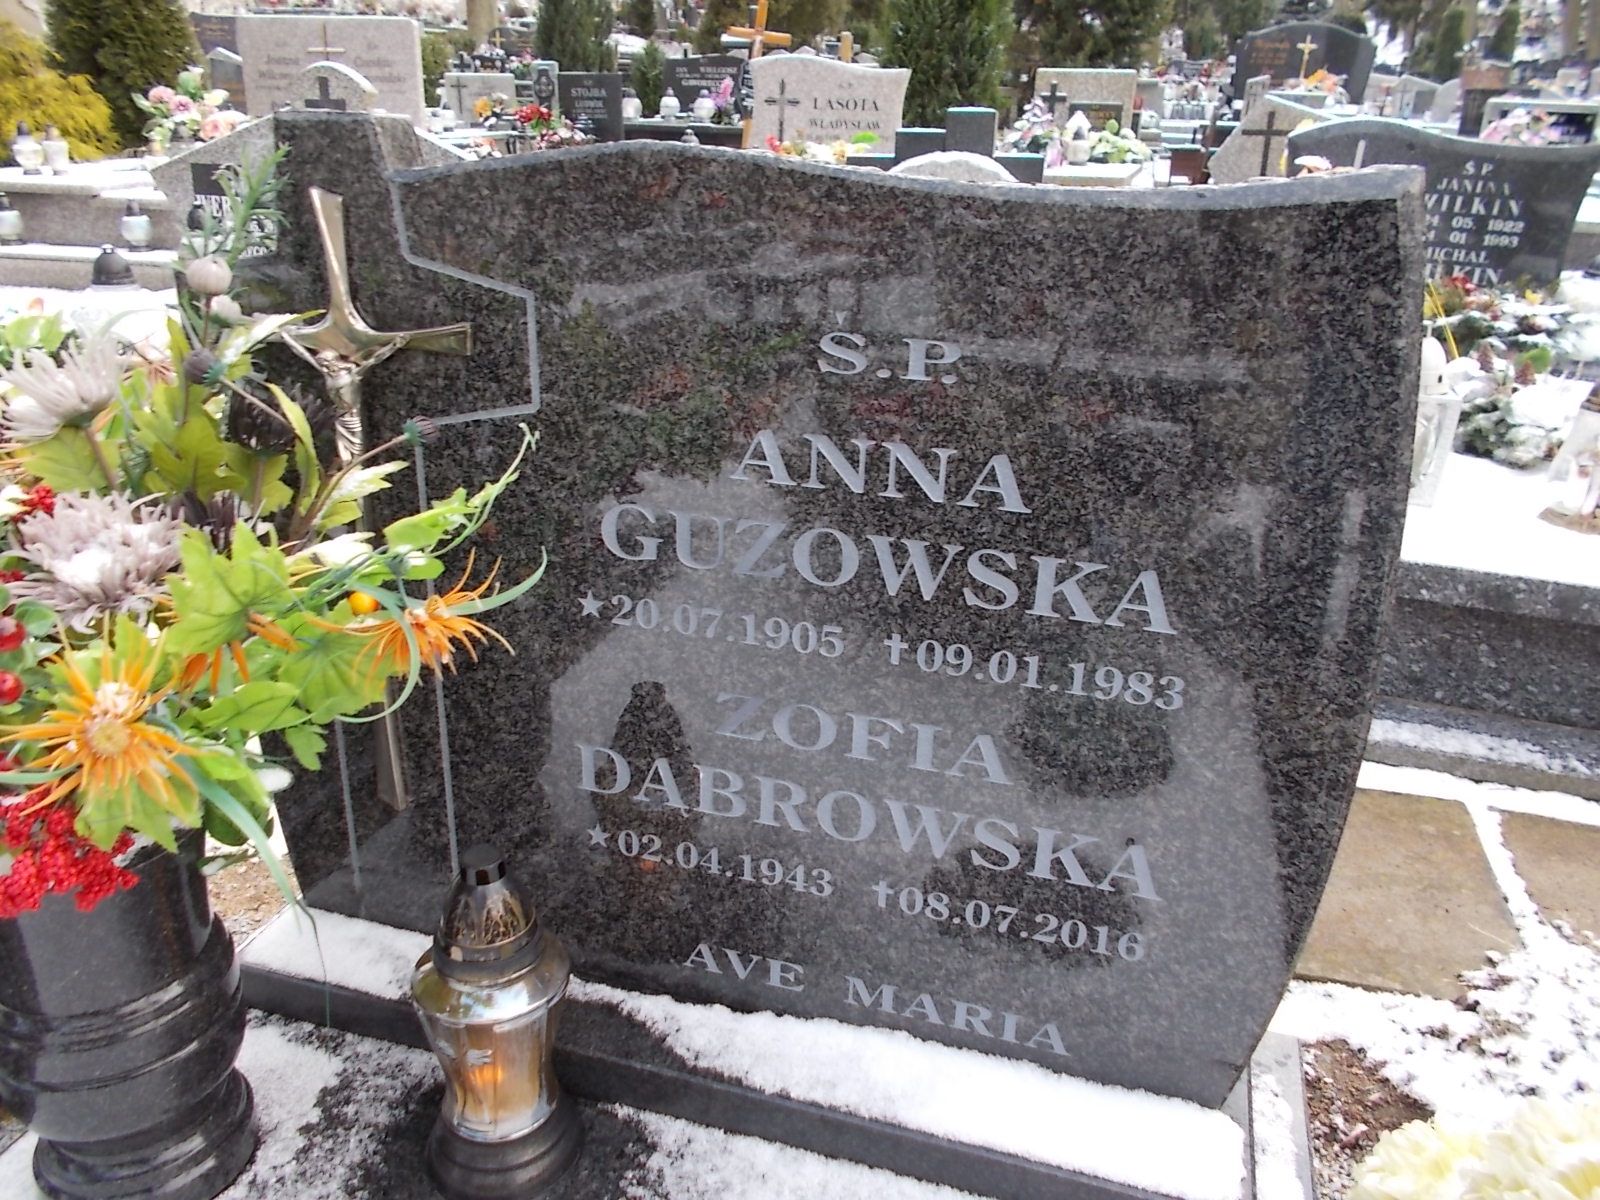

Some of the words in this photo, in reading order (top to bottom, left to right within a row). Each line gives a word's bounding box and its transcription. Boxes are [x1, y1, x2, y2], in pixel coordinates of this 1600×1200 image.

[729, 429, 1033, 514] ANNA
[600, 503, 1178, 635] GUZOWSKA
[715, 691, 1015, 786] ZOFIA
[577, 742, 1164, 901] DĄBROWSKA
[683, 943, 806, 993] AVE
[843, 975, 1071, 1056] MARIA
